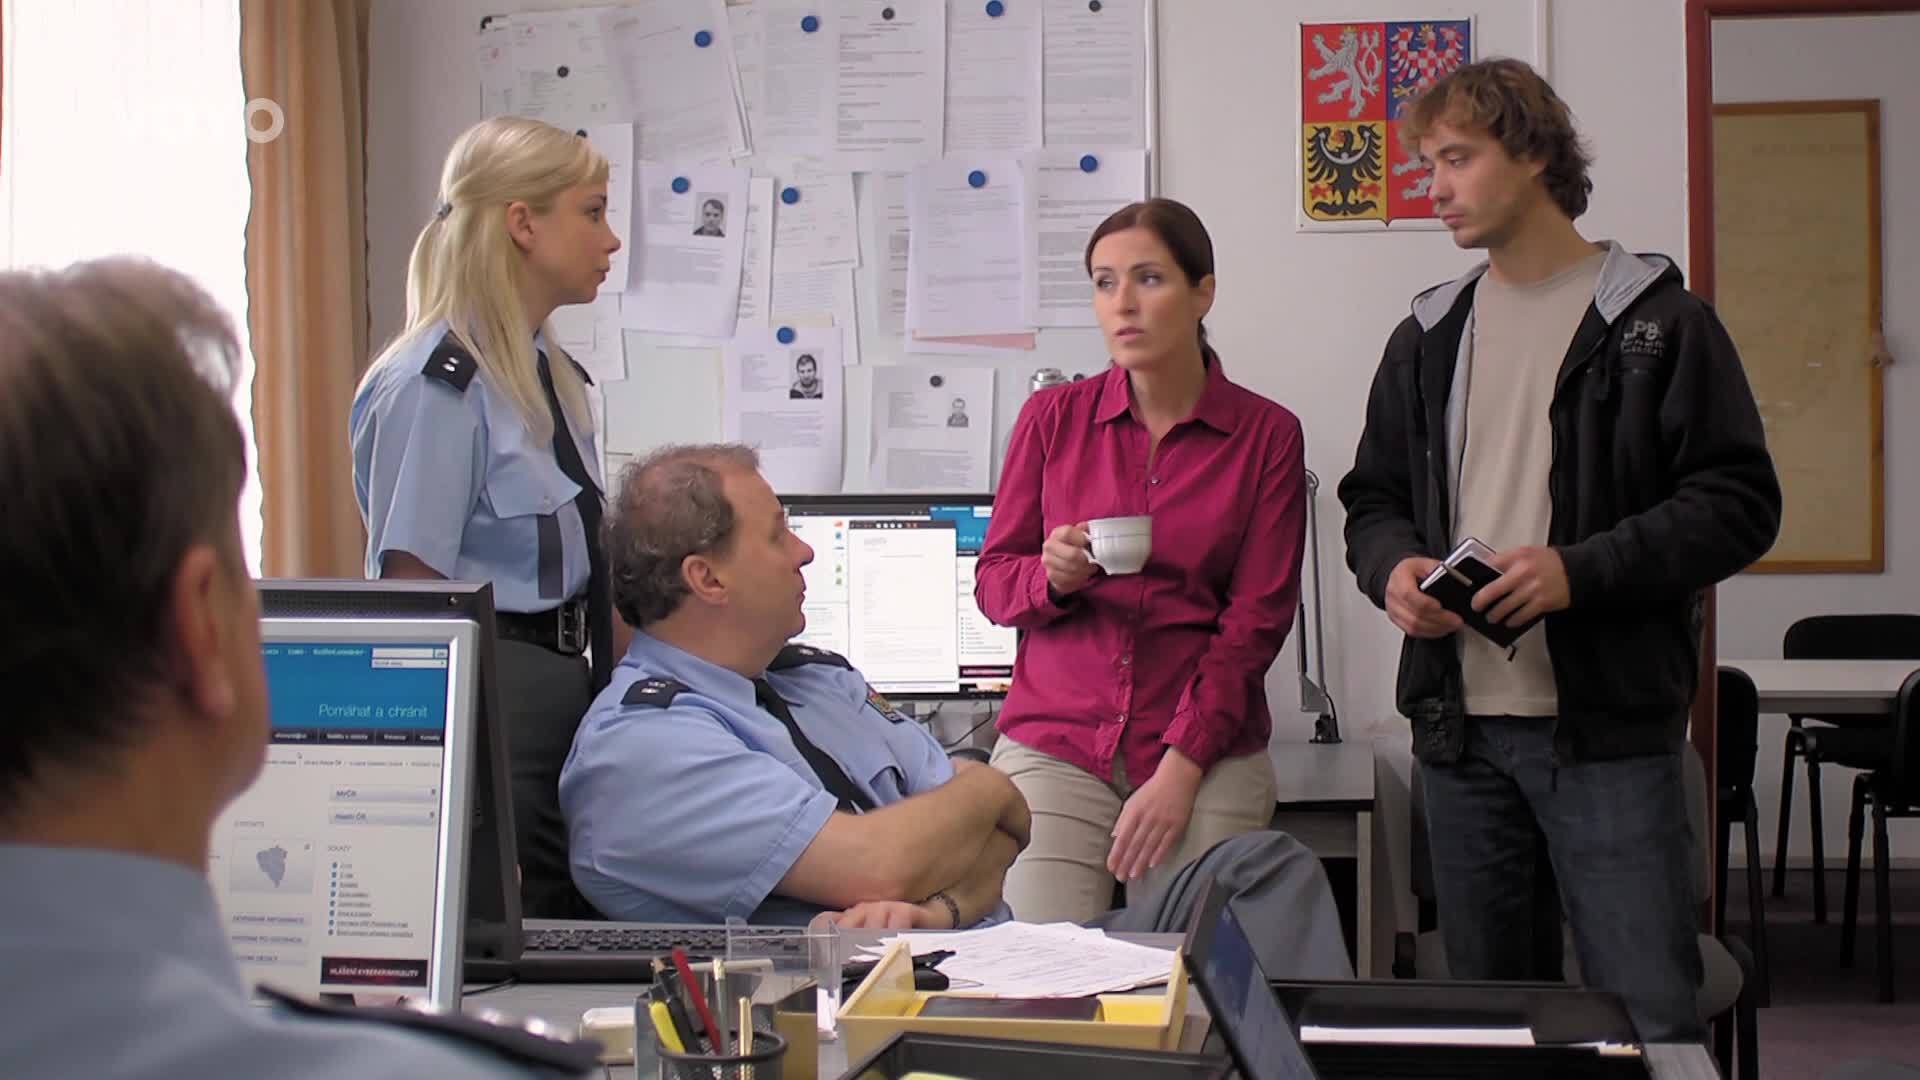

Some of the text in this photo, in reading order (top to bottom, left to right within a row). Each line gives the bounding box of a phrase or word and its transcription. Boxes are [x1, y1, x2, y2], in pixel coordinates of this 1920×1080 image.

[319, 703, 428, 718] Pomáhat a chránit
